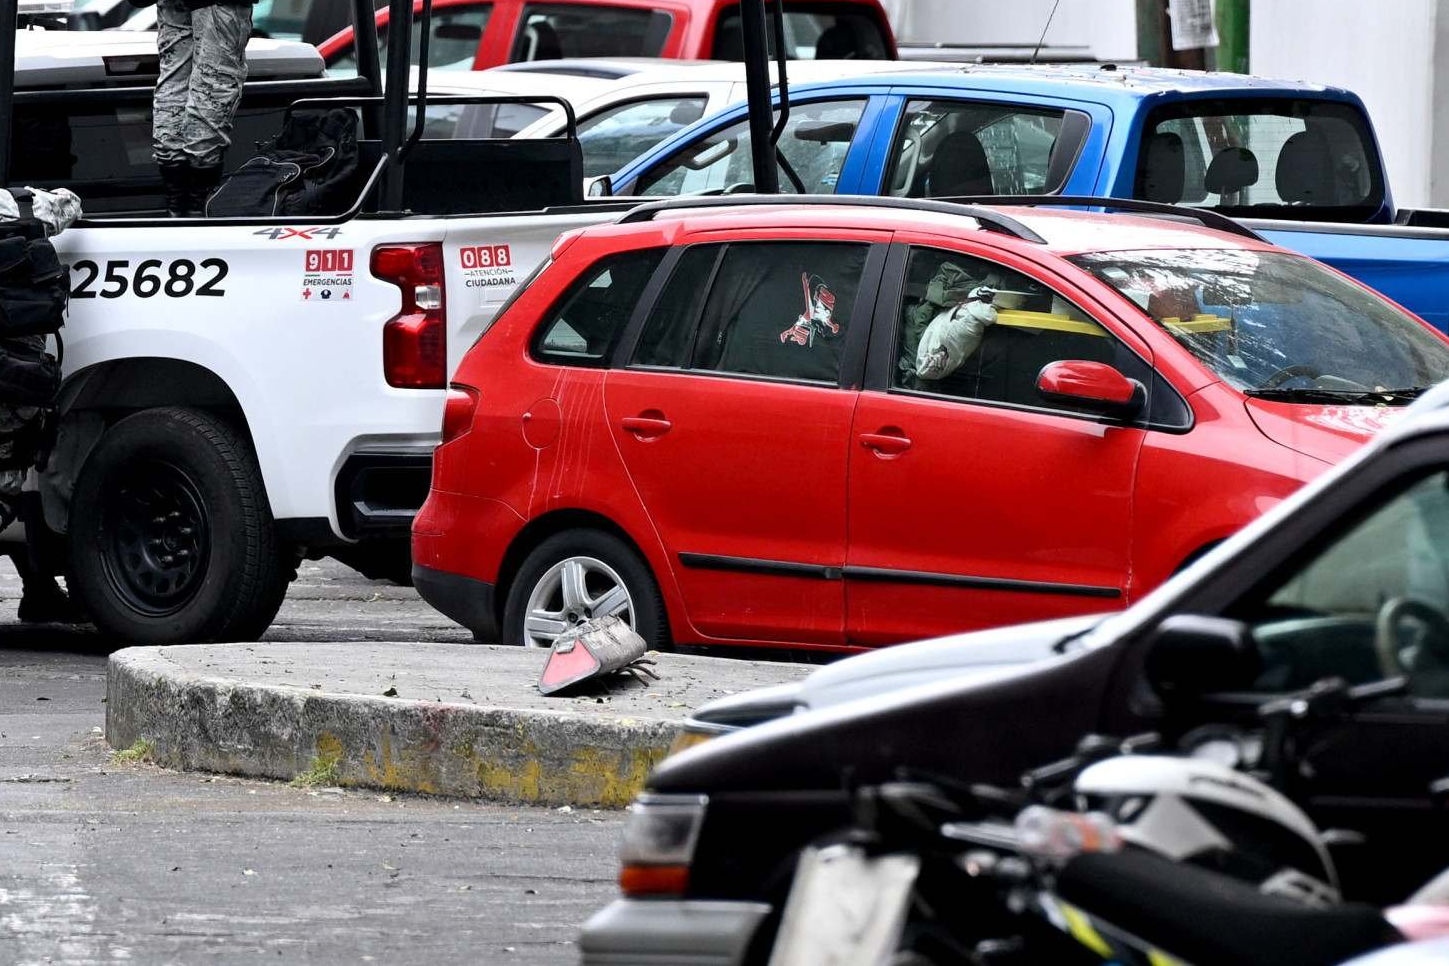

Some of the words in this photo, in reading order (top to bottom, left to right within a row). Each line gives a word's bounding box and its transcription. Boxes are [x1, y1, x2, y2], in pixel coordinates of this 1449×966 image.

[308, 252, 349, 270] 911
[463, 248, 508, 267] 088
[70, 258, 229, 299] 25682
[303, 278, 352, 286] EMERGENCIAS
[465, 277, 516, 288] CIUDADANA
